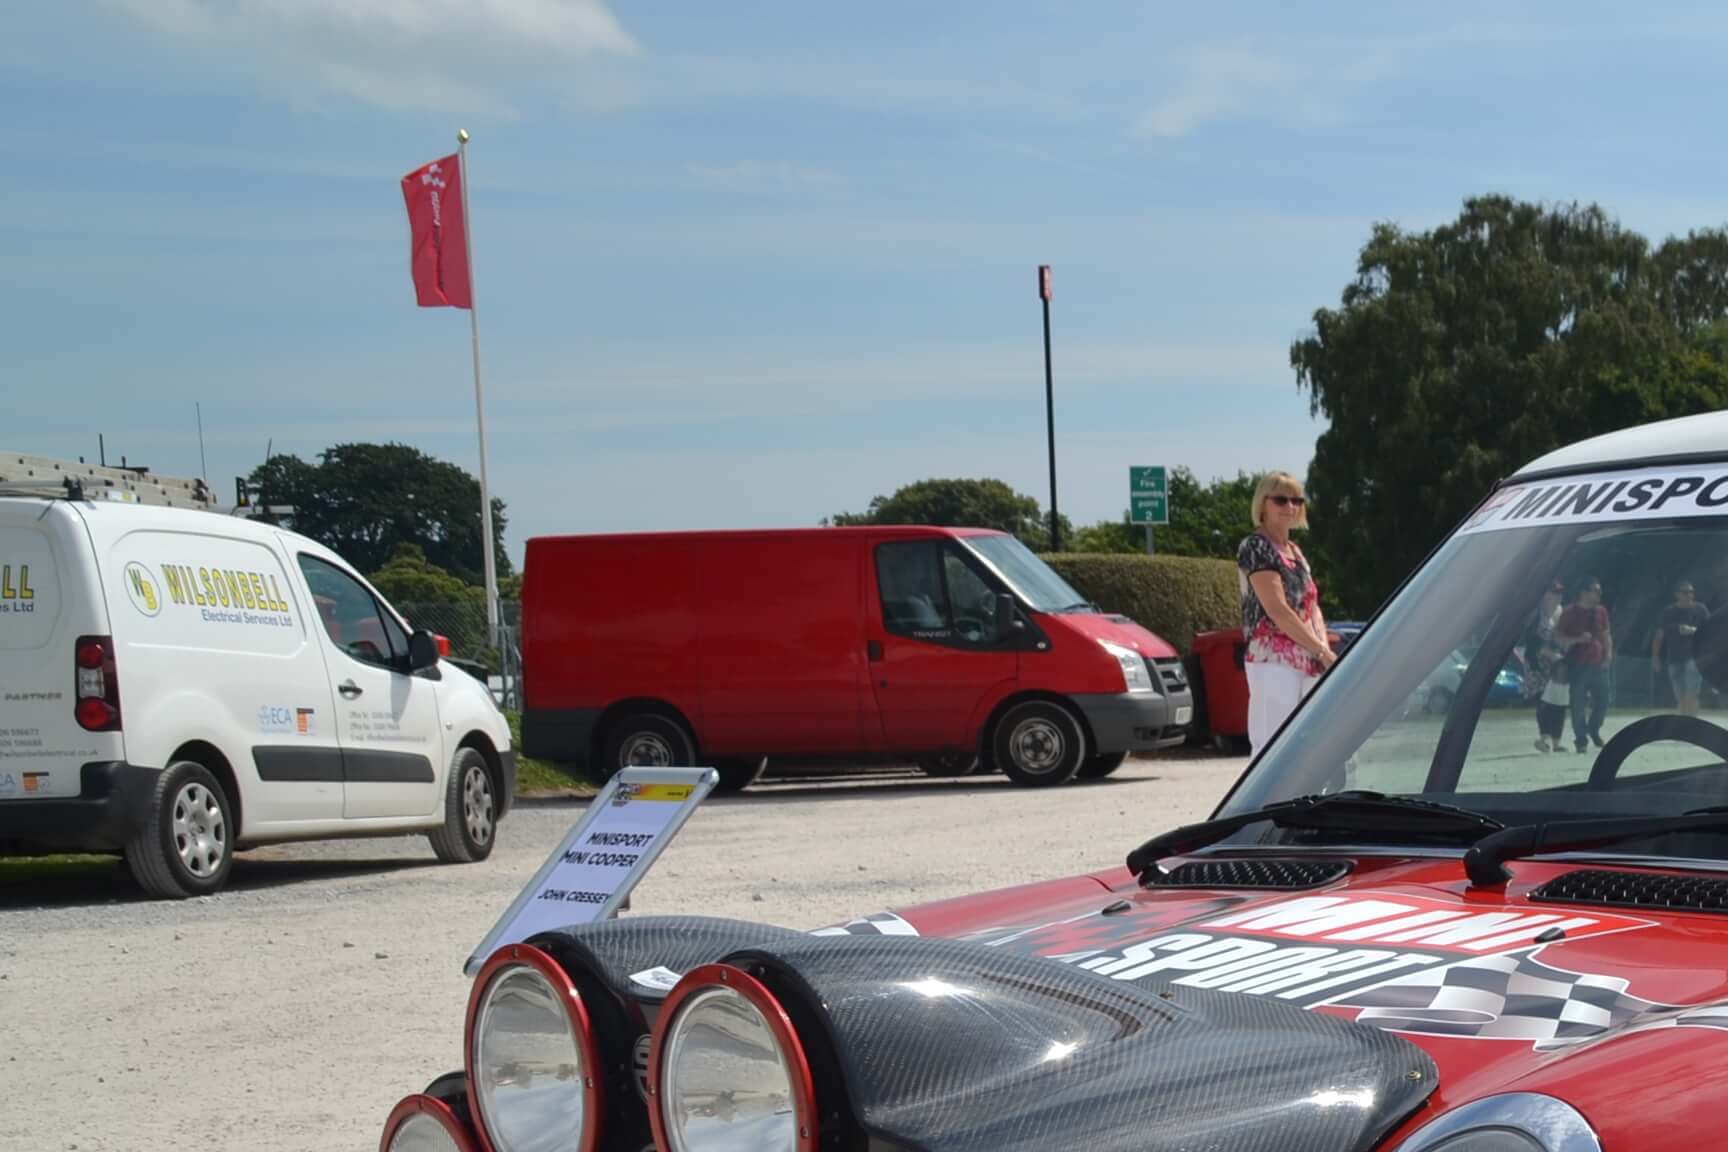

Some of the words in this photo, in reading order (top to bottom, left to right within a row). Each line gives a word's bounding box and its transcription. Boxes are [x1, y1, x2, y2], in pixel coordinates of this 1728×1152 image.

[160, 563, 289, 613] WILSONBELL
[13, 602, 35, 613] Ltd
[201, 608, 242, 624] Electrical
[243, 612, 279, 627] Services
[280, 615, 293, 627] Ltd
[271, 708, 293, 725] ECA
[586, 832, 654, 848] MINISPORT
[559, 850, 591, 865] MINI
[587, 852, 640, 867] COOPER
[538, 889, 567, 902] JOHN
[1199, 896, 1601, 951] MINI
[1078, 933, 1444, 1000] SPORT
